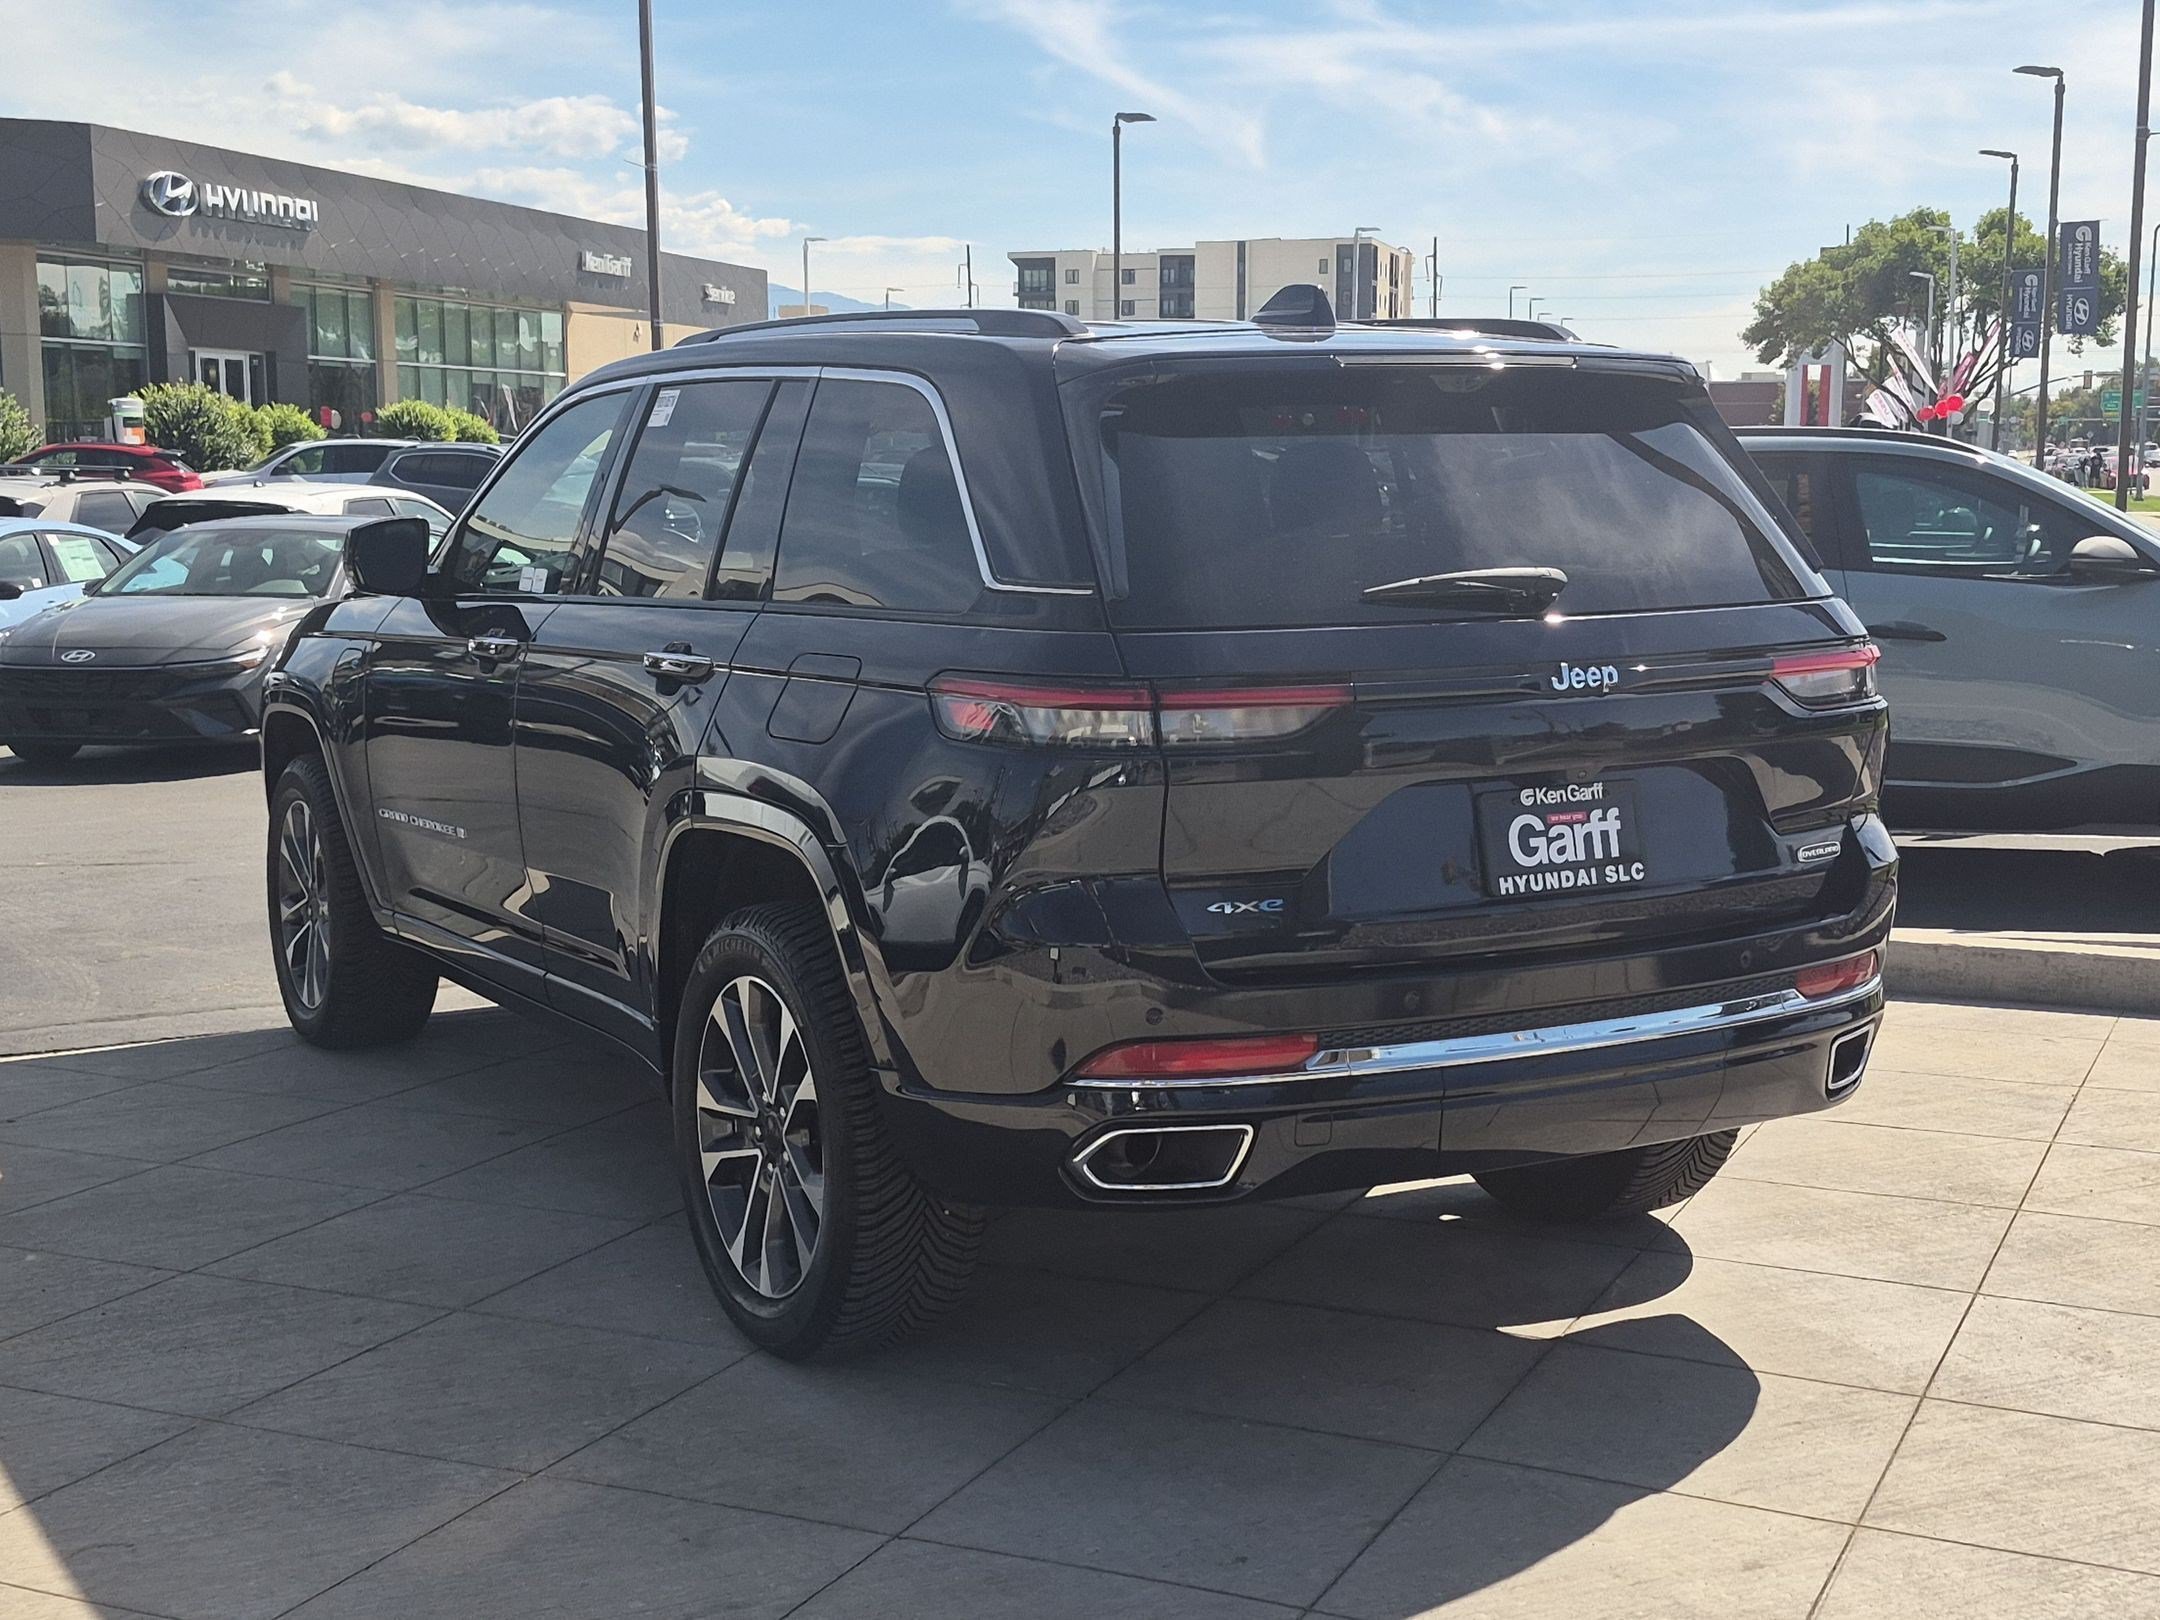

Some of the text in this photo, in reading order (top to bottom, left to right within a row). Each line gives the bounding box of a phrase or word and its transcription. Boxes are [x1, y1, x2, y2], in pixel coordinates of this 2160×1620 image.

[204, 182, 319, 222] HYUNDAI
[2073, 242, 2084, 284] Hyundai
[1551, 661, 1619, 693] Jeep
[1508, 807, 1622, 867] Garff
[1498, 861, 1645, 896] HYUNDAI SLC
